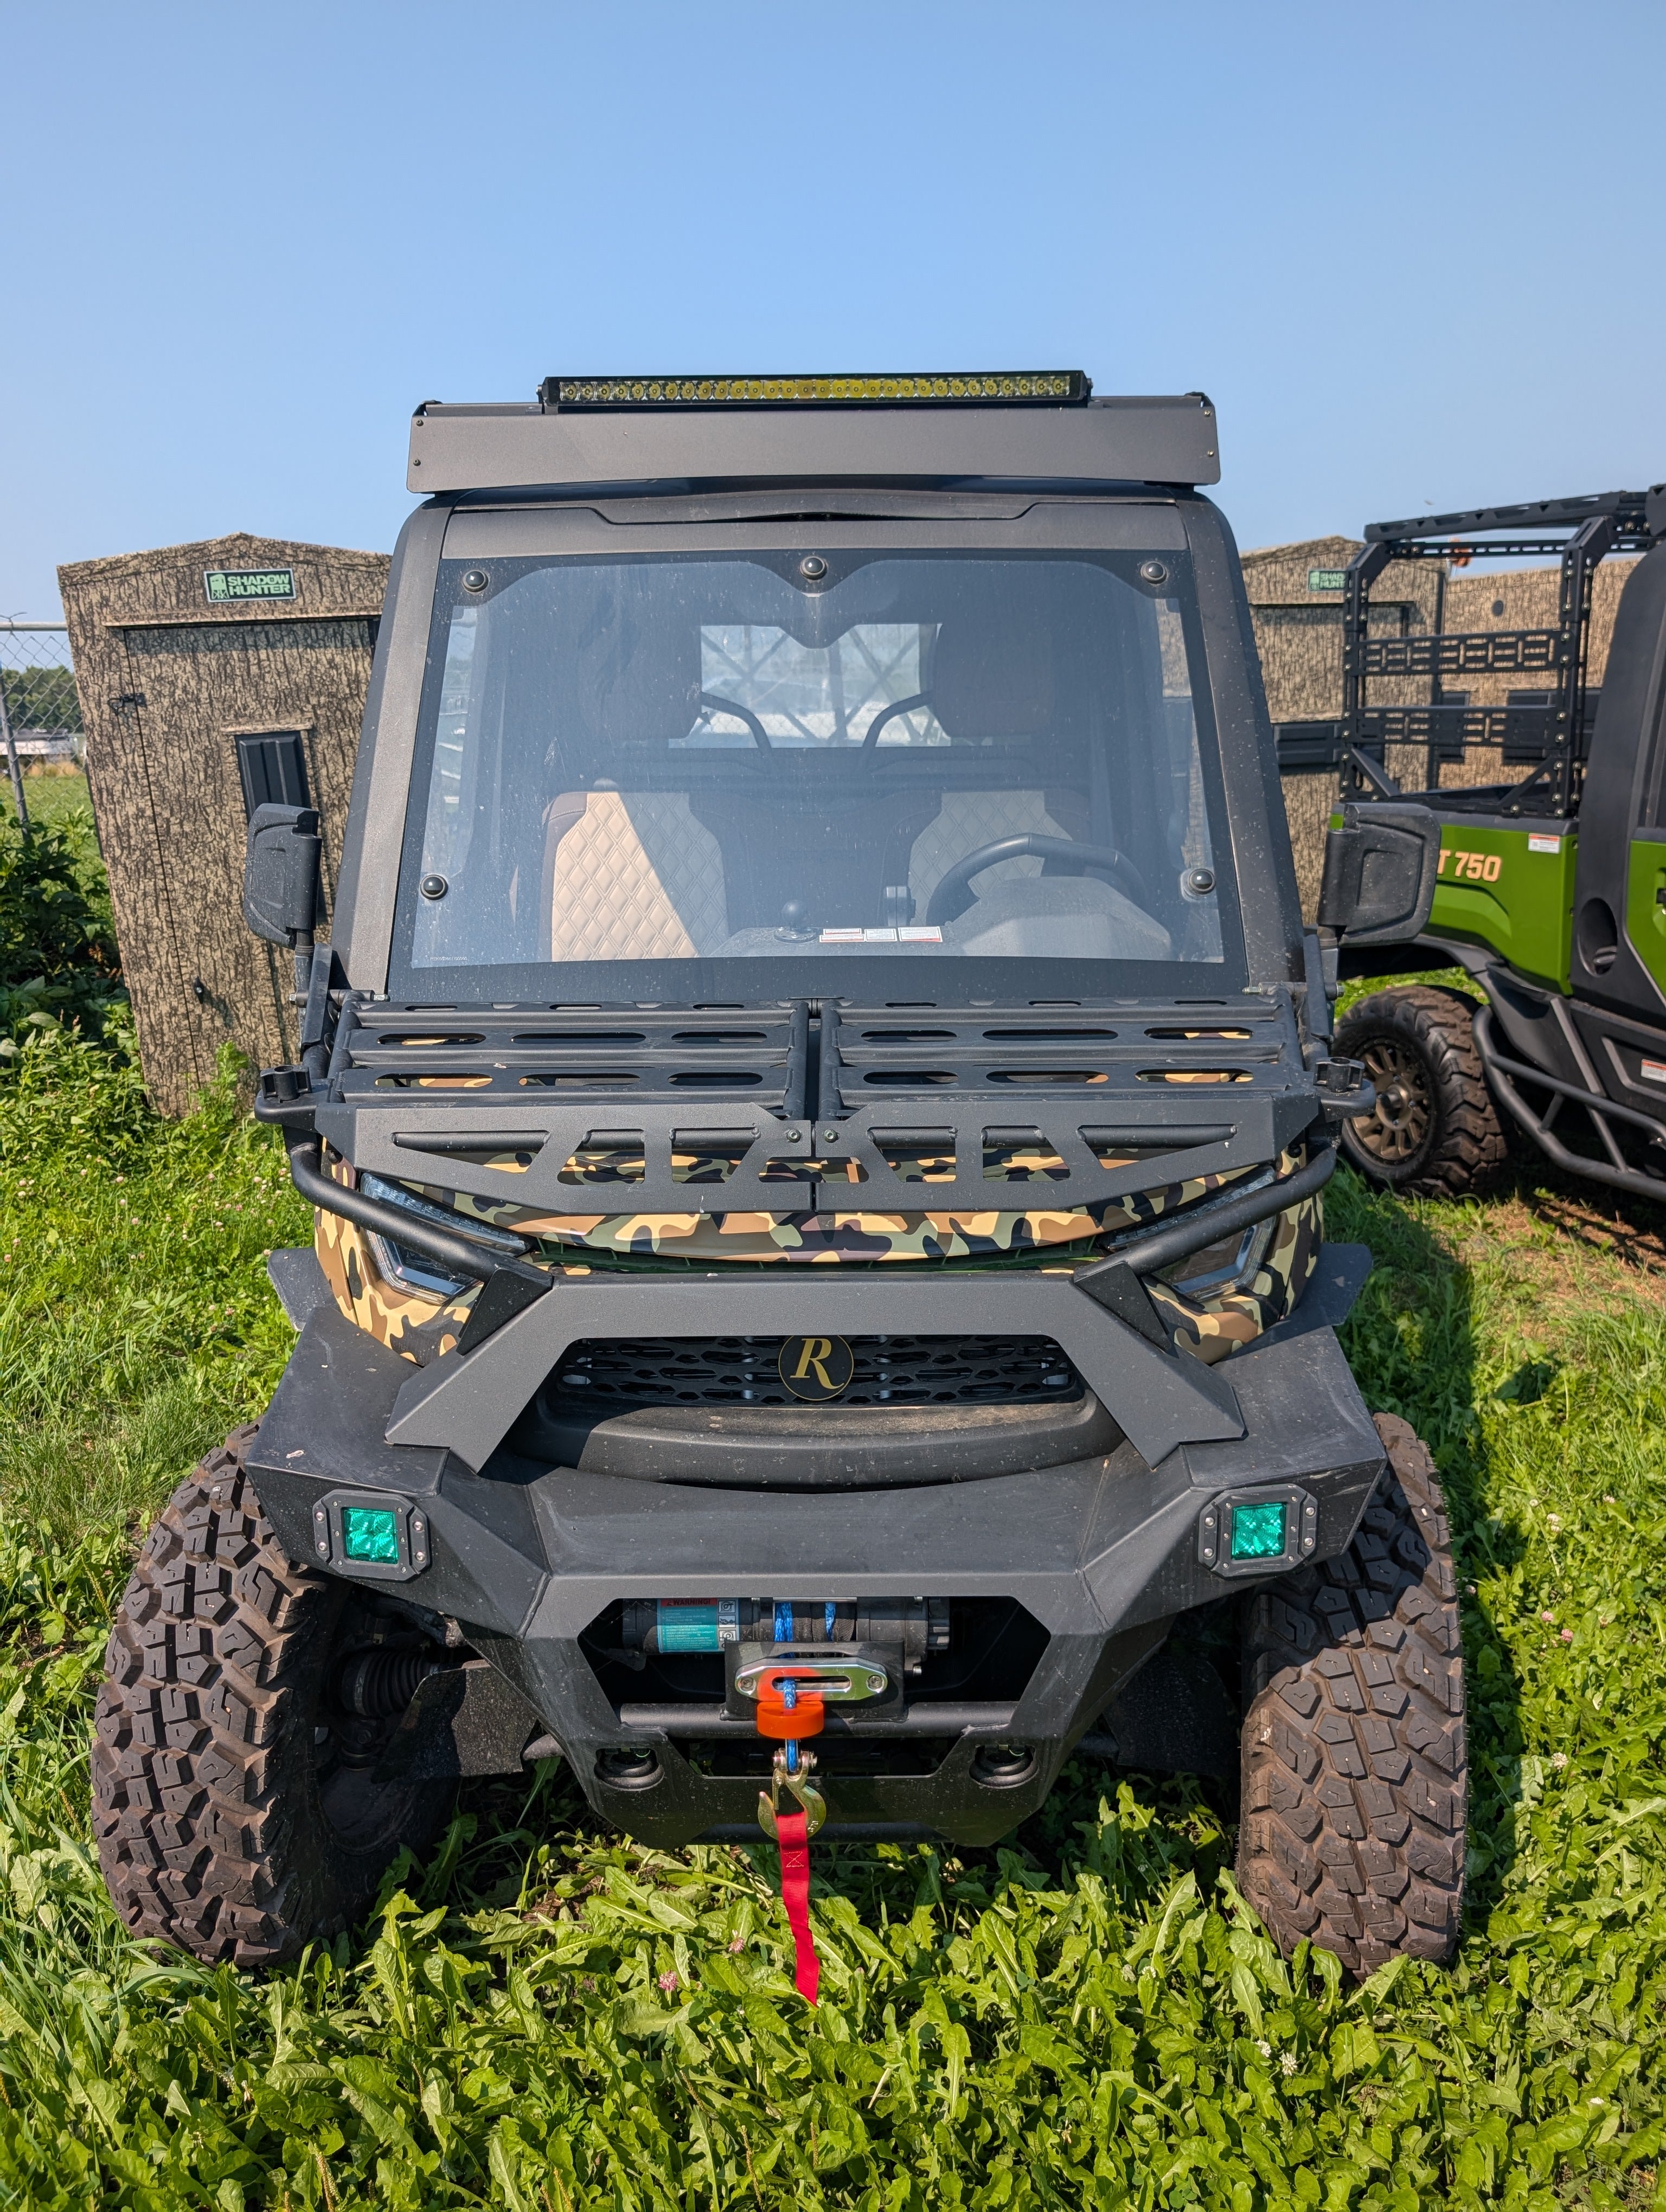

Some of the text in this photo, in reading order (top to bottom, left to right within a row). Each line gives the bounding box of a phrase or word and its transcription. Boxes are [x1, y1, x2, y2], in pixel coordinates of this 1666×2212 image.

[227, 574, 290, 586] SHADOW
[229, 584, 291, 595] HUNTER
[1454, 851, 1502, 882] 750
[790, 1338, 844, 1390] R
